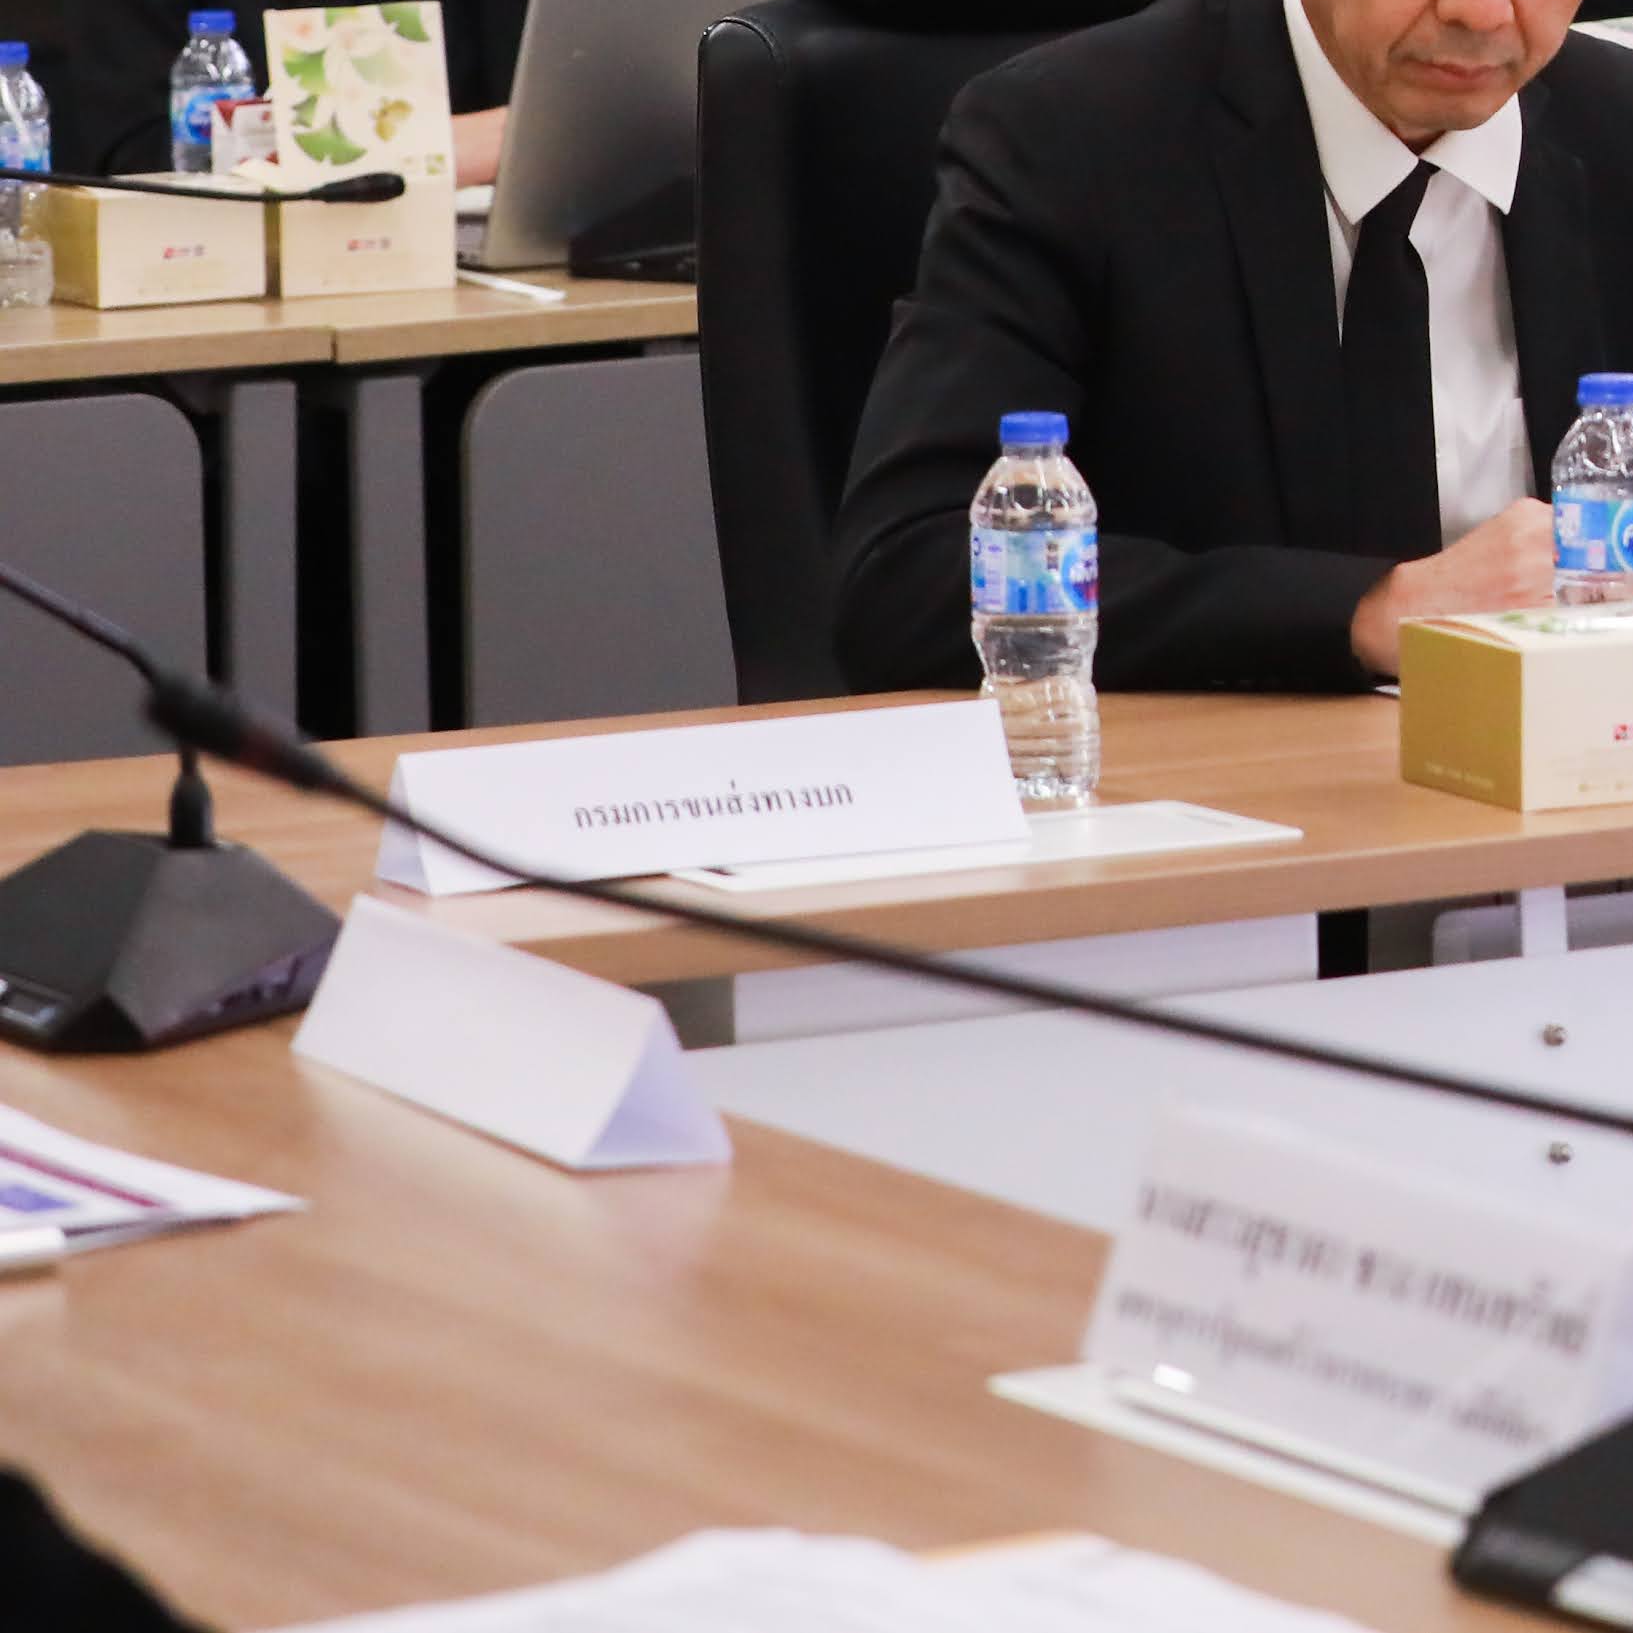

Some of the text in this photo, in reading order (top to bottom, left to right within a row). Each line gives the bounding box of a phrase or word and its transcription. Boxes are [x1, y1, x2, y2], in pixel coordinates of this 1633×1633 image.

[574, 779, 855, 829] กรมการขนส่งทางบก
